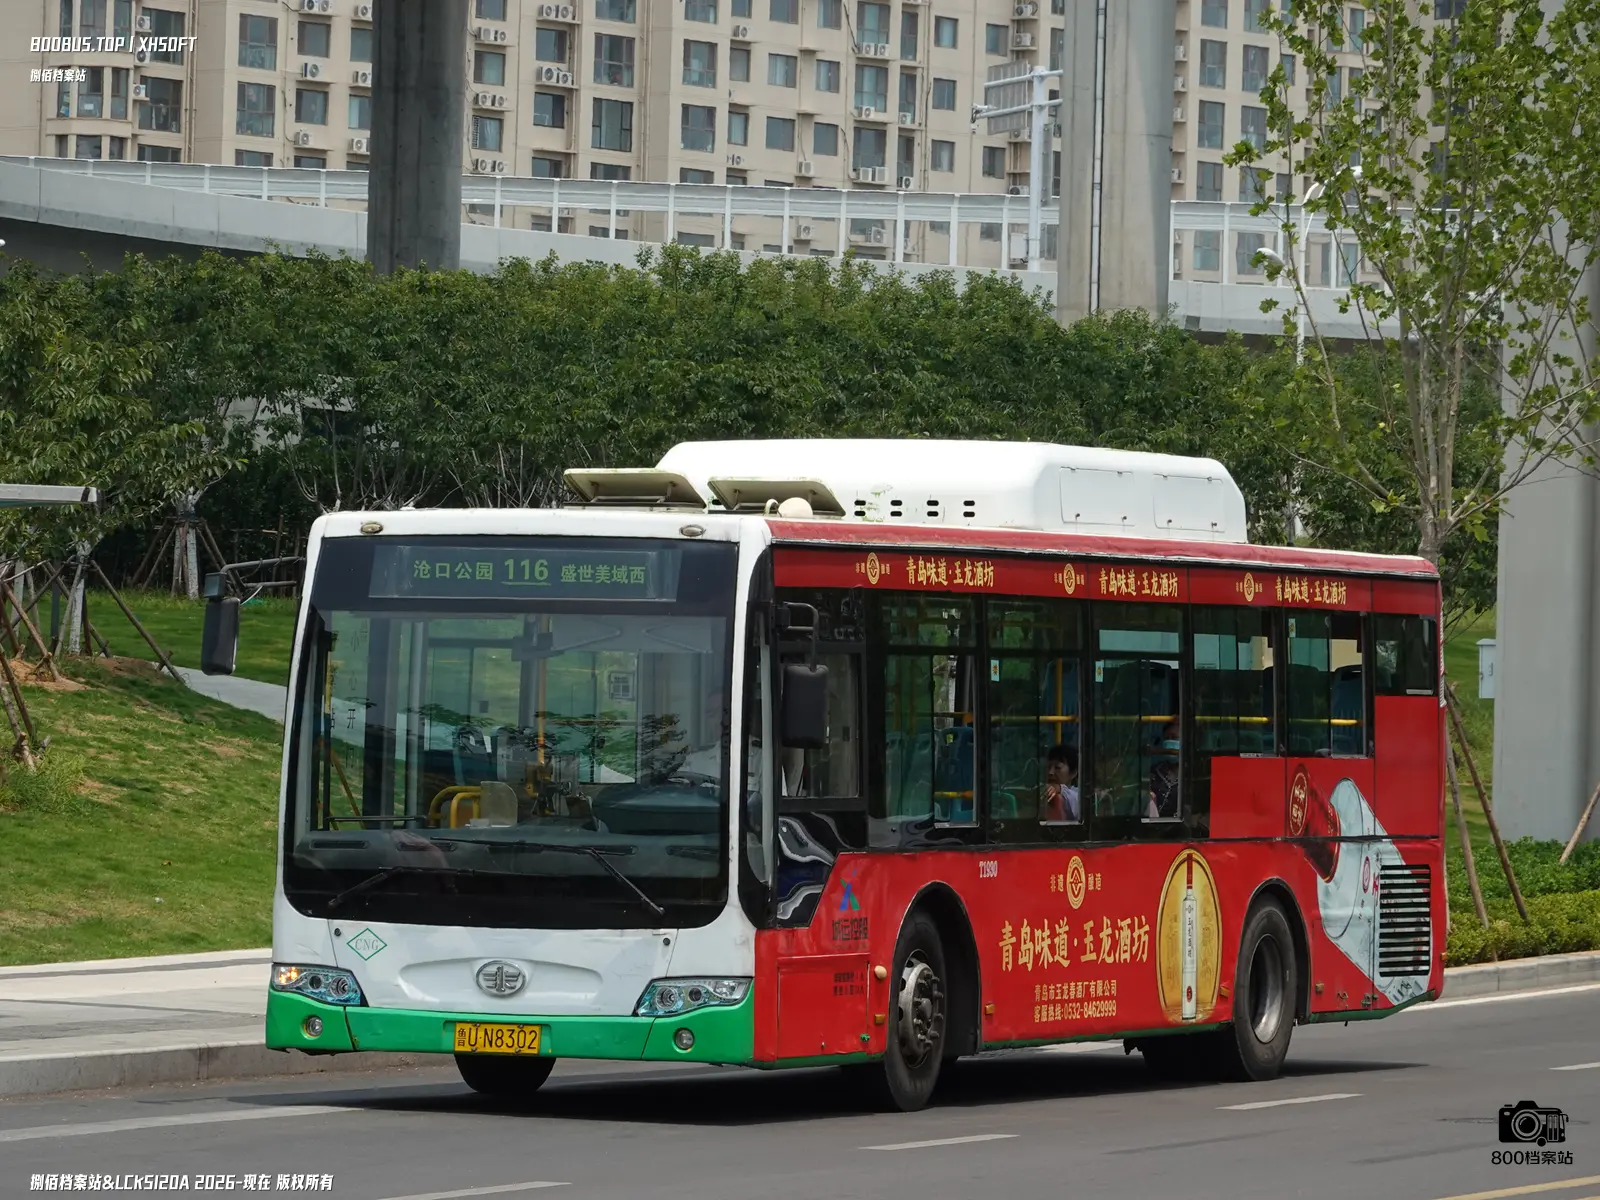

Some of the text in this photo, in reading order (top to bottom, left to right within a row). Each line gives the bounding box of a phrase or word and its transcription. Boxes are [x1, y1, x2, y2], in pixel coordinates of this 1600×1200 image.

[413, 558, 646, 585] 沧口公园 116 盛世美域西
[354, 937, 380, 951] CNG
[1034, 979, 1117, 1002] 青岛市玉龙春酒厂有限公司
